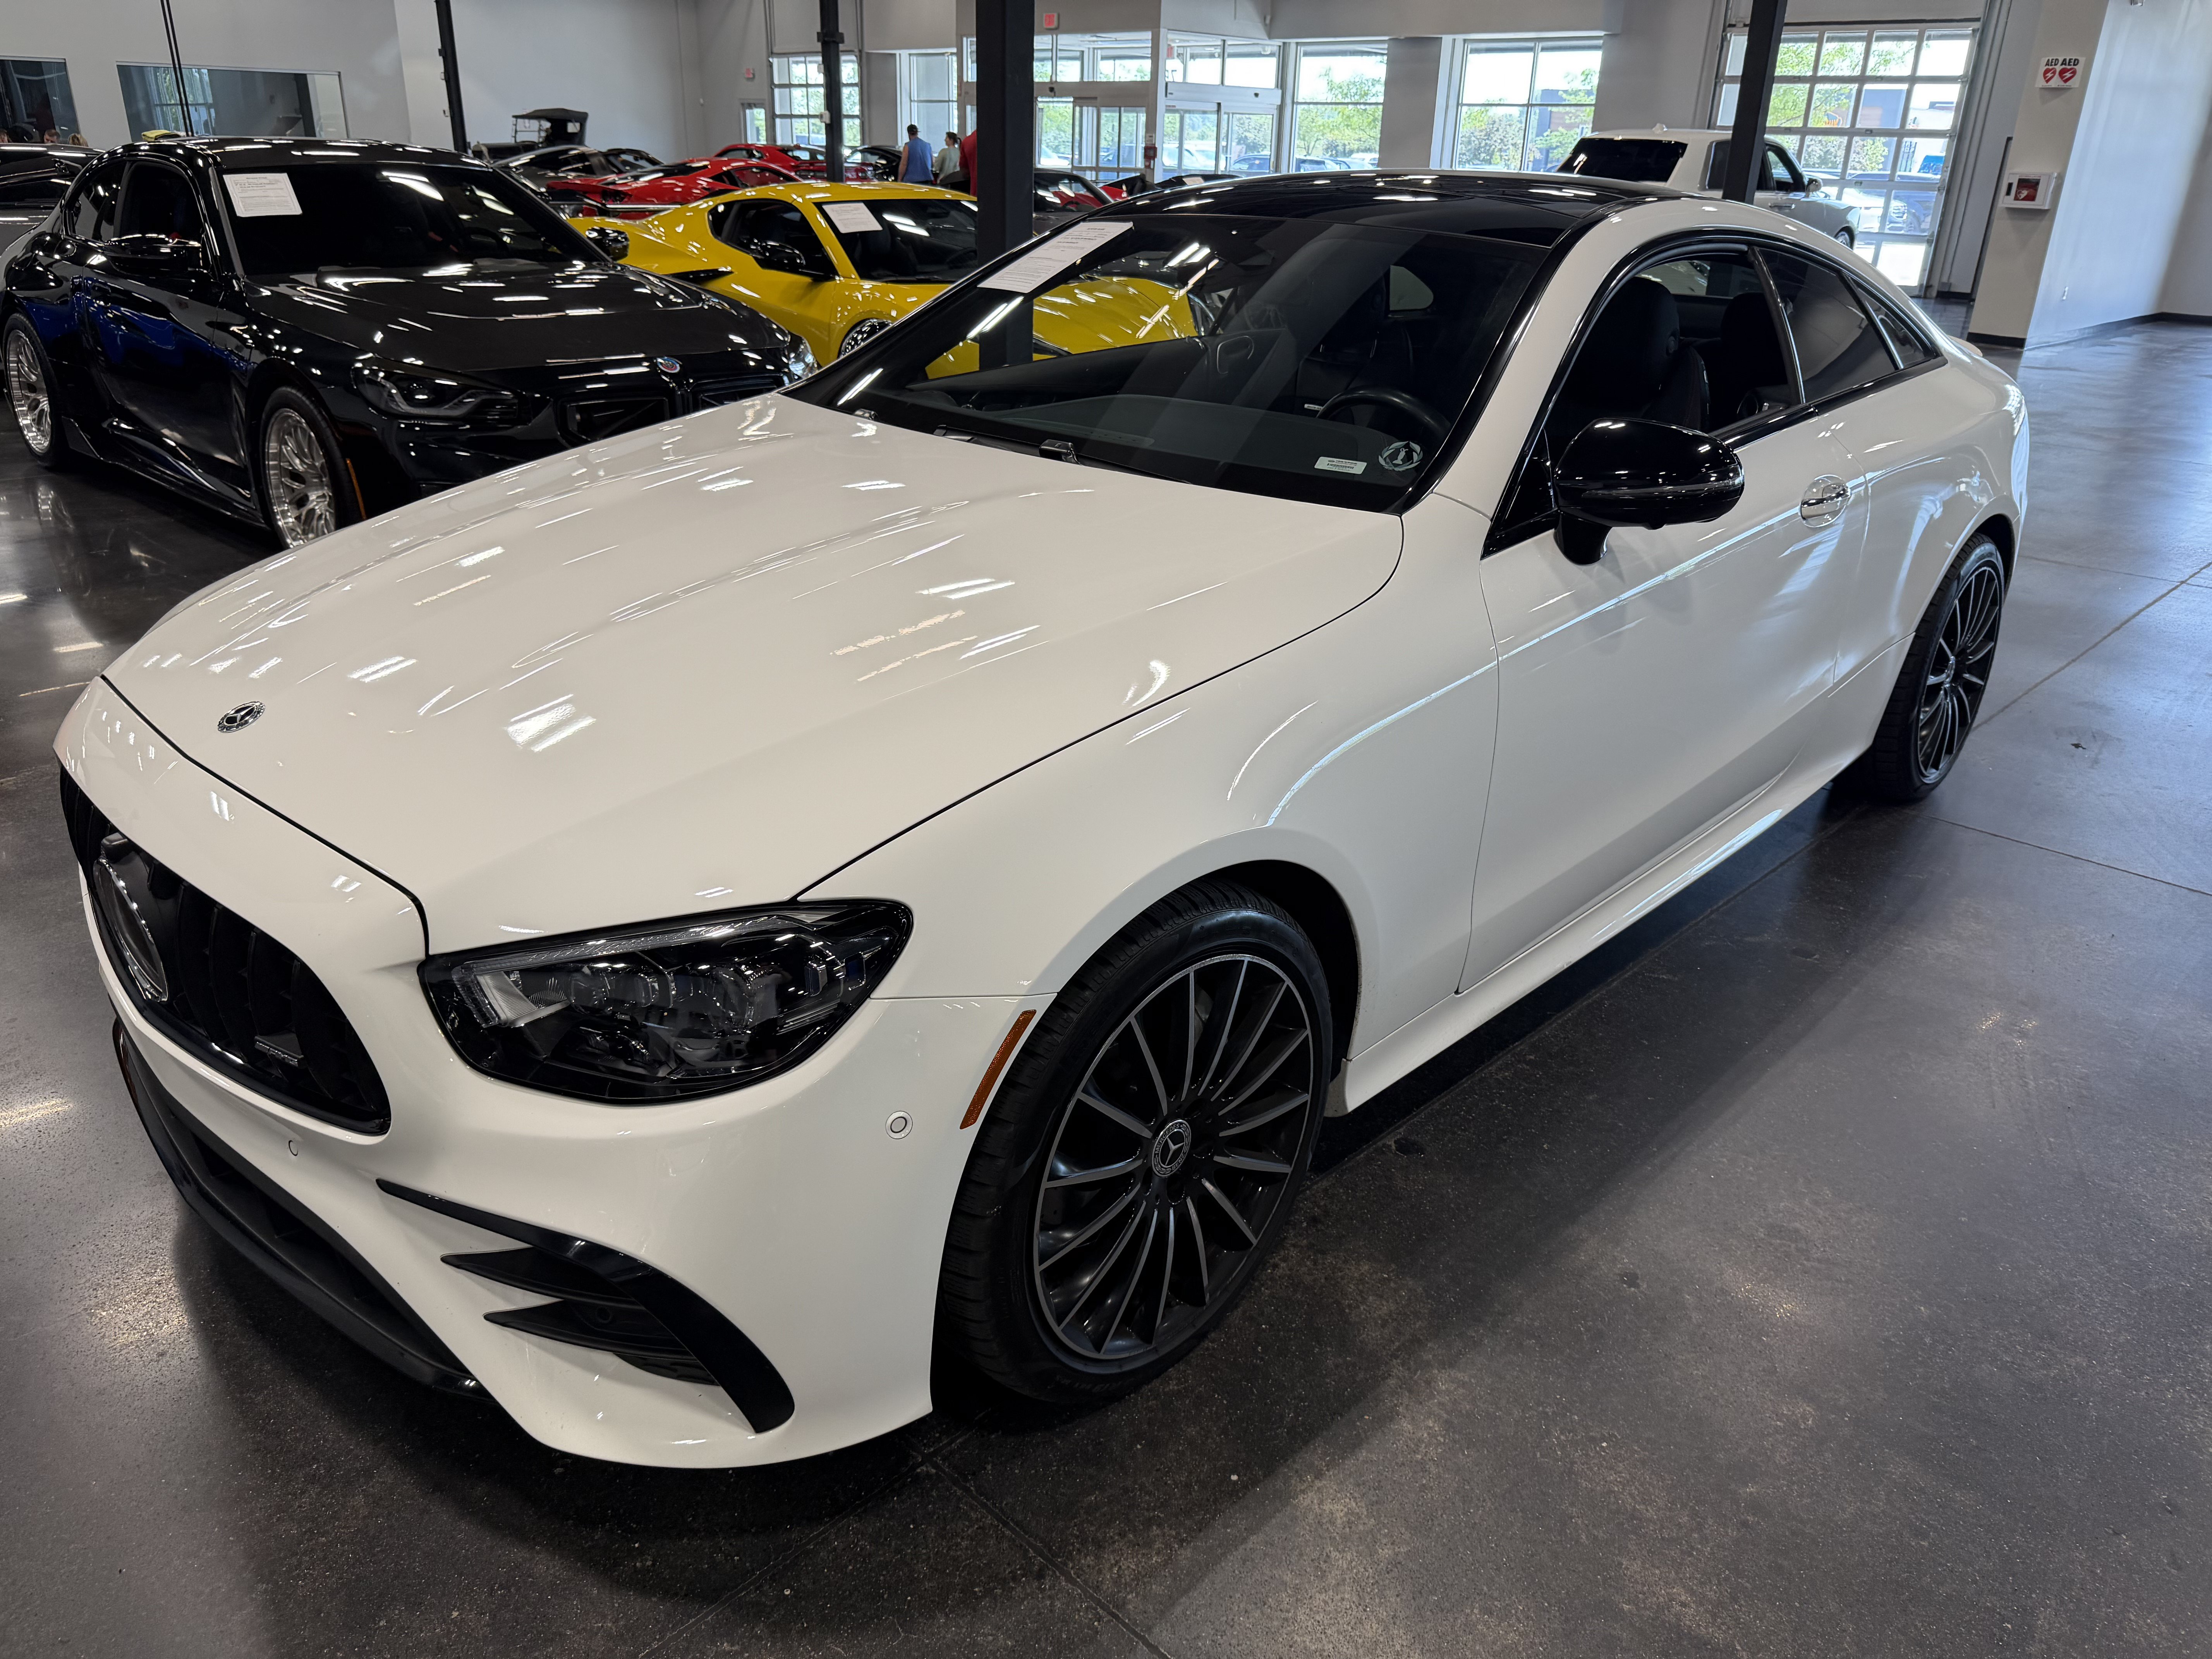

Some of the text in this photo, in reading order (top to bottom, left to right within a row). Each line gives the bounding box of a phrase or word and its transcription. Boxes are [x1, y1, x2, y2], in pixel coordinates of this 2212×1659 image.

[2045, 58, 2059, 67] AED
[2060, 58, 2080, 66] AED
[1155, 1123, 1180, 1154] MERCEDES
[1171, 1153, 1185, 1171] BENZ
